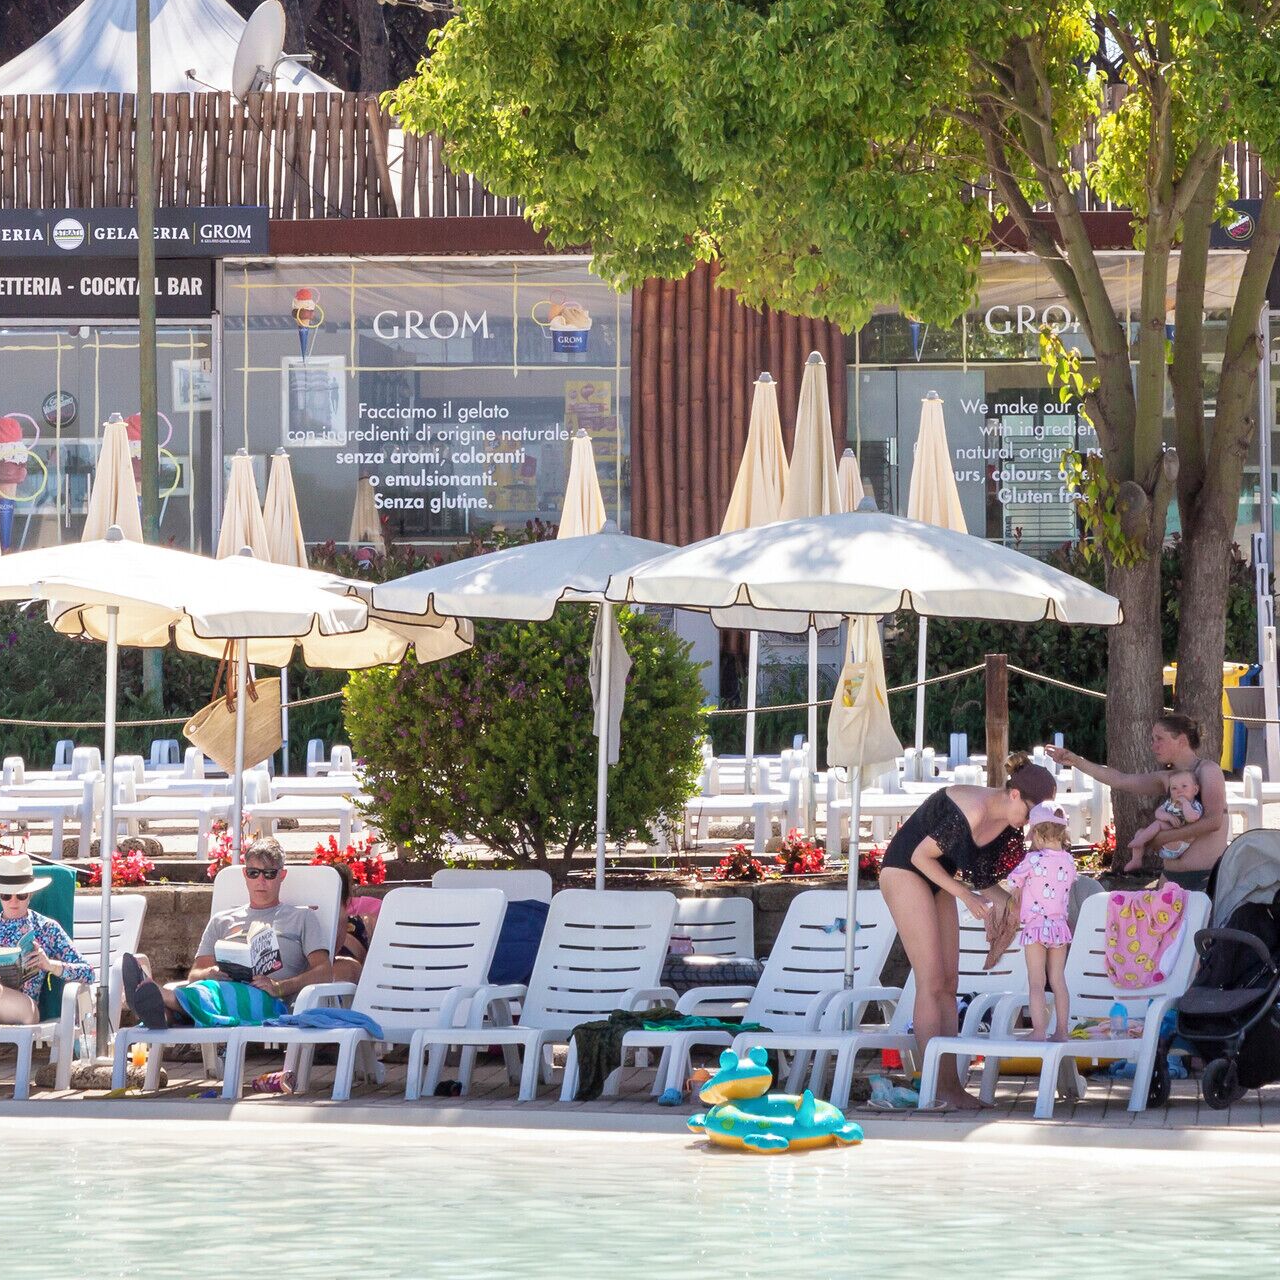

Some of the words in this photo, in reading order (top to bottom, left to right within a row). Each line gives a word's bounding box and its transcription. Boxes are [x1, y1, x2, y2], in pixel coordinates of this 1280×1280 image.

[94, 227, 190, 240] GELAERIA
[200, 224, 252, 239] GROM
[80, 276, 162, 296] COCKTAL
[167, 276, 203, 296] BAR
[373, 310, 489, 340] GROM
[557, 336, 583, 344] GROM
[359, 402, 437, 419] Facciamo
[443, 400, 452, 419] il
[457, 400, 509, 424] gelato
[960, 398, 989, 414] We
[994, 396, 1039, 414] make
[1043, 402, 1072, 414] our
[287, 430, 315, 441] con
[322, 423, 409, 446] ingredienti
[415, 423, 431, 441] di
[437, 425, 496, 446] origine
[978, 418, 1013, 437] with
[1019, 418, 1097, 441] ingredien
[335, 452, 384, 464] senza
[390, 447, 446, 467] aromi,
[451, 446, 526, 464] coloranti
[956, 441, 1013, 459] natural
[368, 474, 380, 487] o
[385, 469, 498, 487] emulsionanti.
[991, 464, 1052, 481] colours
[374, 492, 424, 509] Senza
[430, 491, 493, 514] glutine.
[998, 486, 1053, 504] Gluten
